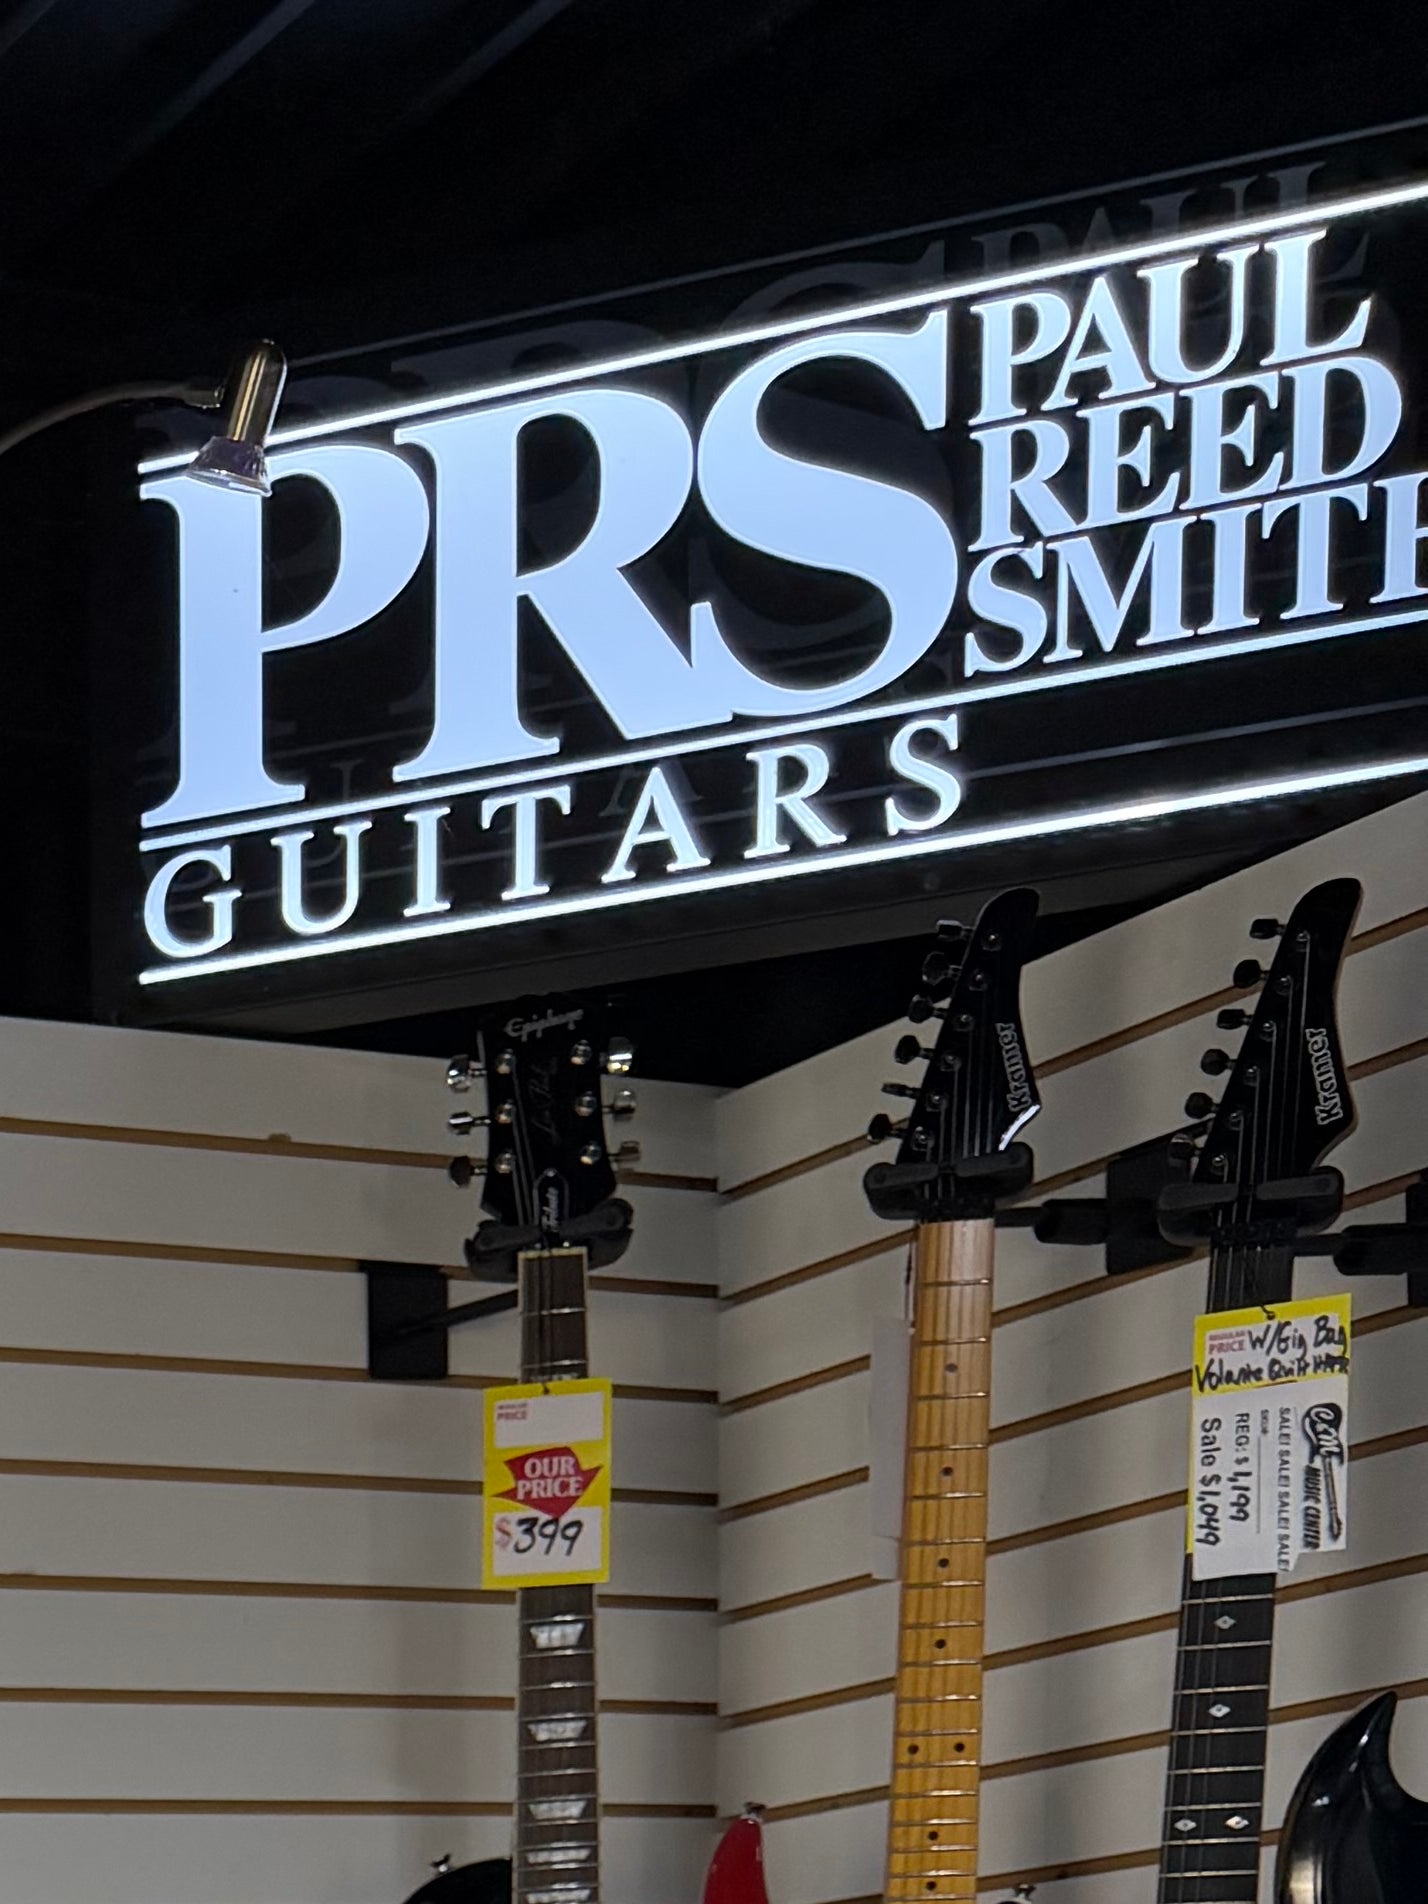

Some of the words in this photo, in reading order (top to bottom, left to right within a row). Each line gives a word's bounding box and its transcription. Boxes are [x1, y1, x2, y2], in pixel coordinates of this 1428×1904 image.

[969, 227, 1374, 427] PAUL
[968, 355, 1404, 555] REED
[139, 312, 960, 831] PRS
[142, 712, 966, 960] GUITARS
[994, 1022, 1032, 1113] Kramer
[1305, 1027, 1344, 1126] Kramer
[1208, 1341, 1245, 1355] PRICE
[523, 1455, 577, 1479] OUR
[1200, 1416, 1223, 1468] Sale
[516, 1475, 585, 1500] PRICE
[1302, 1463, 1322, 1505] MUSIC
[1301, 1506, 1322, 1551] CENTER
